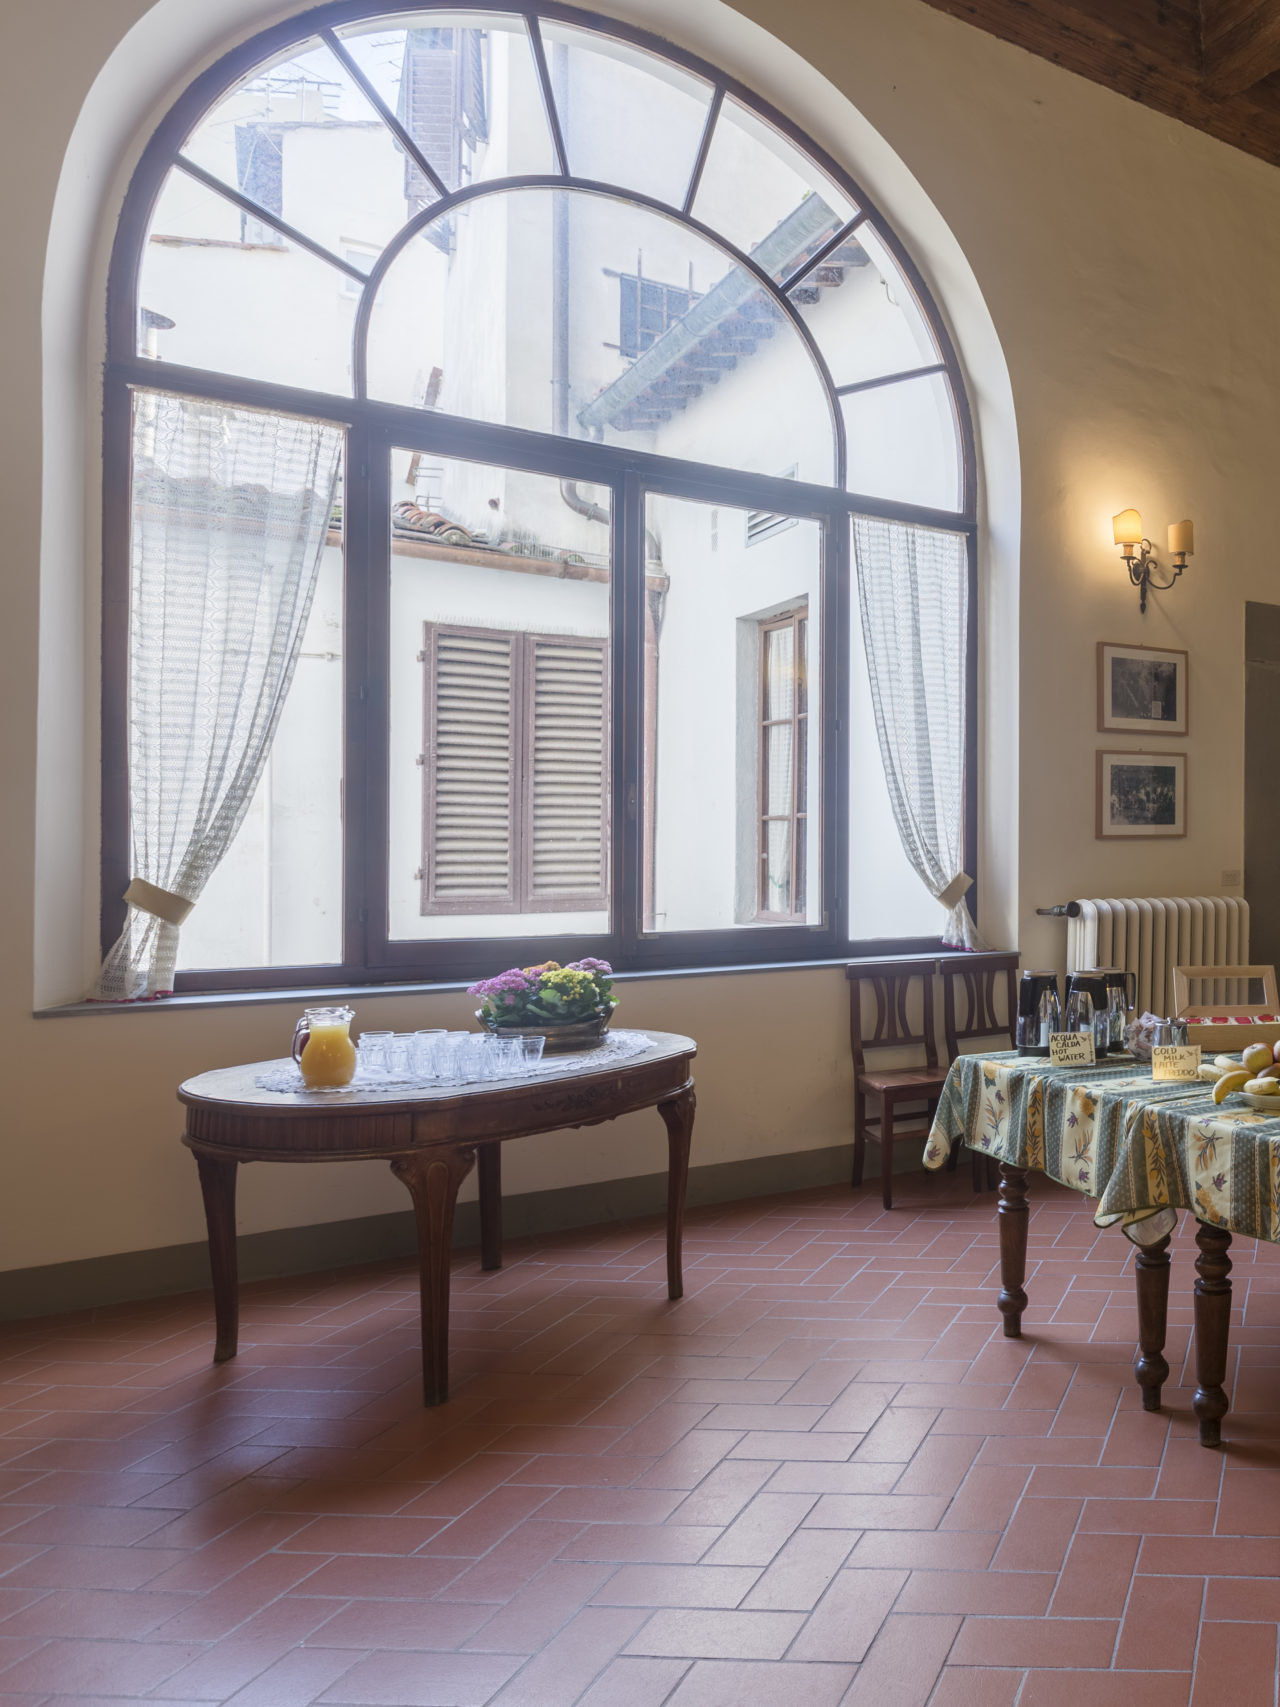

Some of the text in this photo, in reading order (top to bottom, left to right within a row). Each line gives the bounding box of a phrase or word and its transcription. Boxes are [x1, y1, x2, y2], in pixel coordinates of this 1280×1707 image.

[1051, 1034, 1078, 1042] ACQUA
[1153, 1048, 1177, 1056] COLD
[1058, 1053, 1085, 1061] WATER
